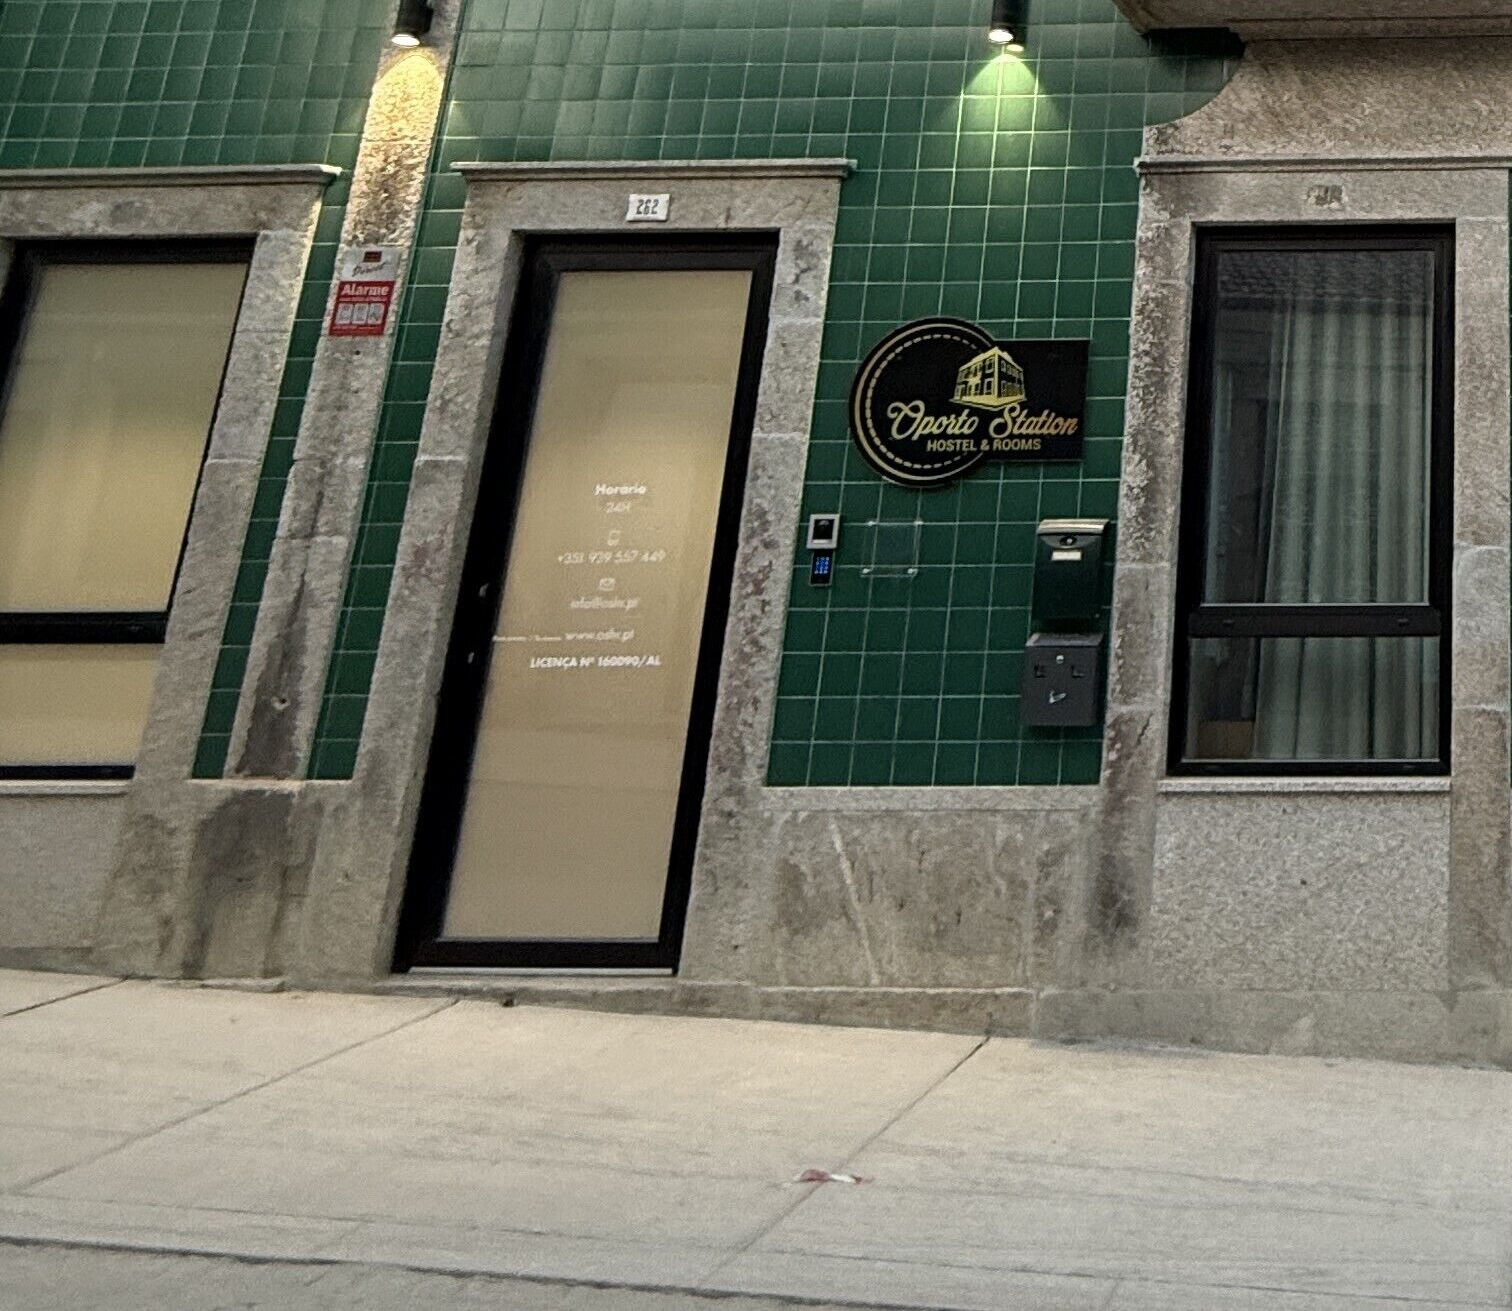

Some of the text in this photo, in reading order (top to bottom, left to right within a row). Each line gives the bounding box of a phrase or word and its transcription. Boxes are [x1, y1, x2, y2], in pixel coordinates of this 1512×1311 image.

[636, 198, 660, 215] 262
[341, 283, 390, 296] Alarme
[887, 400, 1078, 441] Oporto Station
[926, 438, 1042, 452] HOSTEL & ROOMS
[529, 656, 578, 669] LICENÇA
